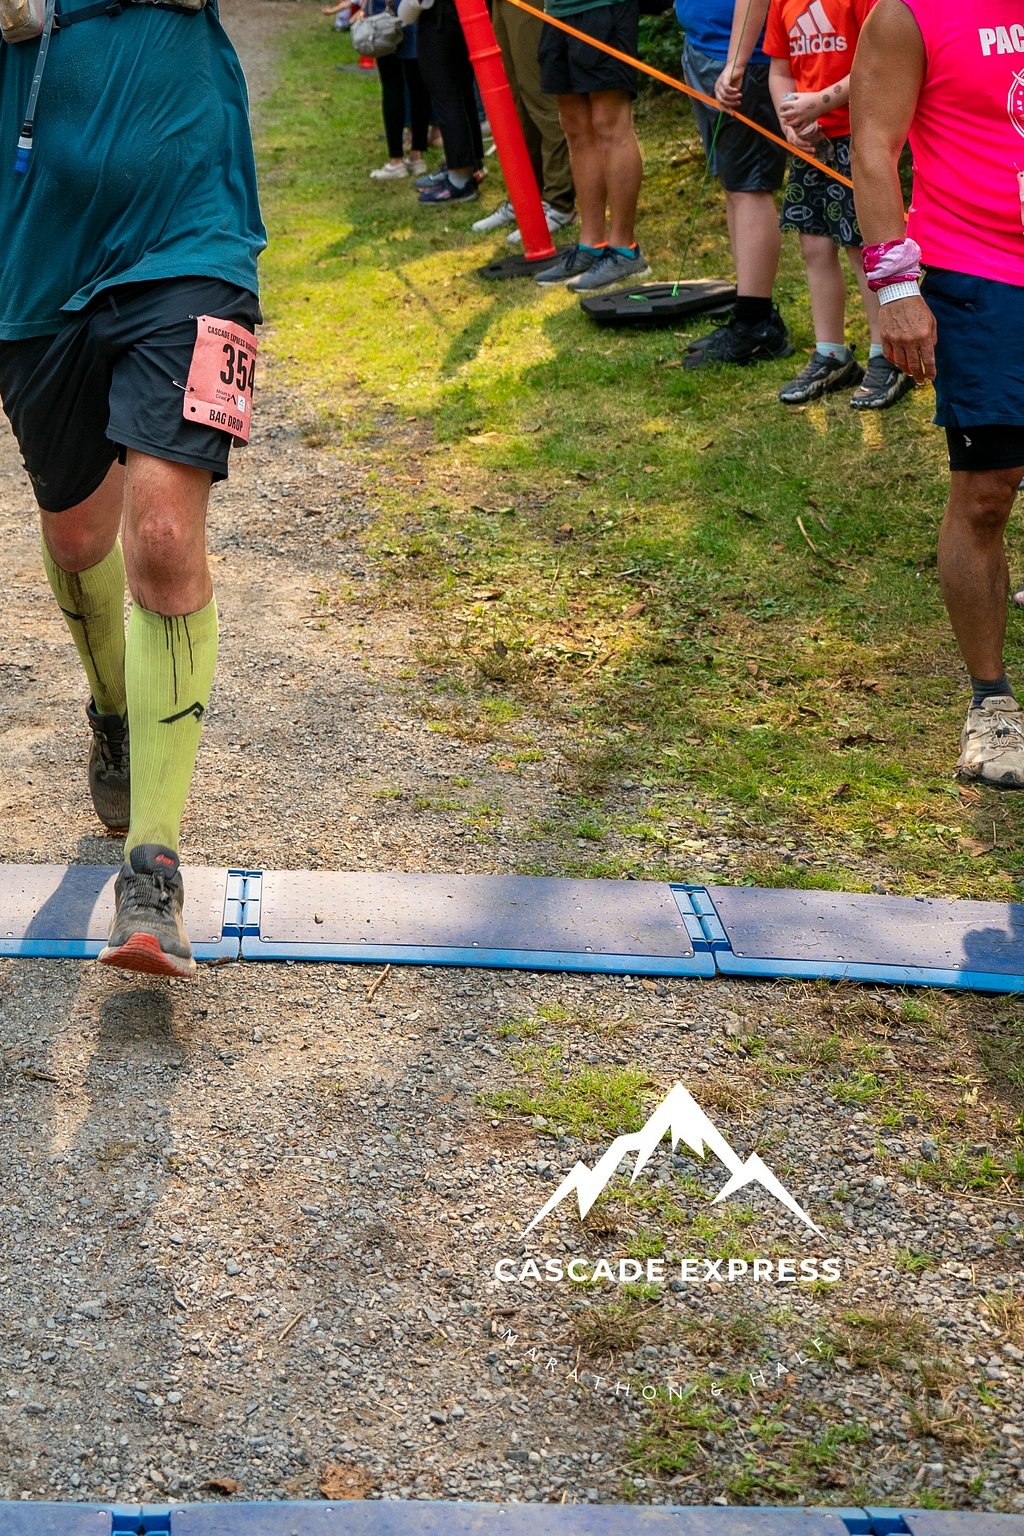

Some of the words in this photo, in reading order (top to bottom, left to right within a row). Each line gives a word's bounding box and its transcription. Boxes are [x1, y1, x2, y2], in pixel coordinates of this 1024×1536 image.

[208, 325, 230, 340] CASCADE
[230, 333, 246, 348] EXPRESS
[209, 409, 227, 425] BAG
[228, 415, 244, 432] DROP
